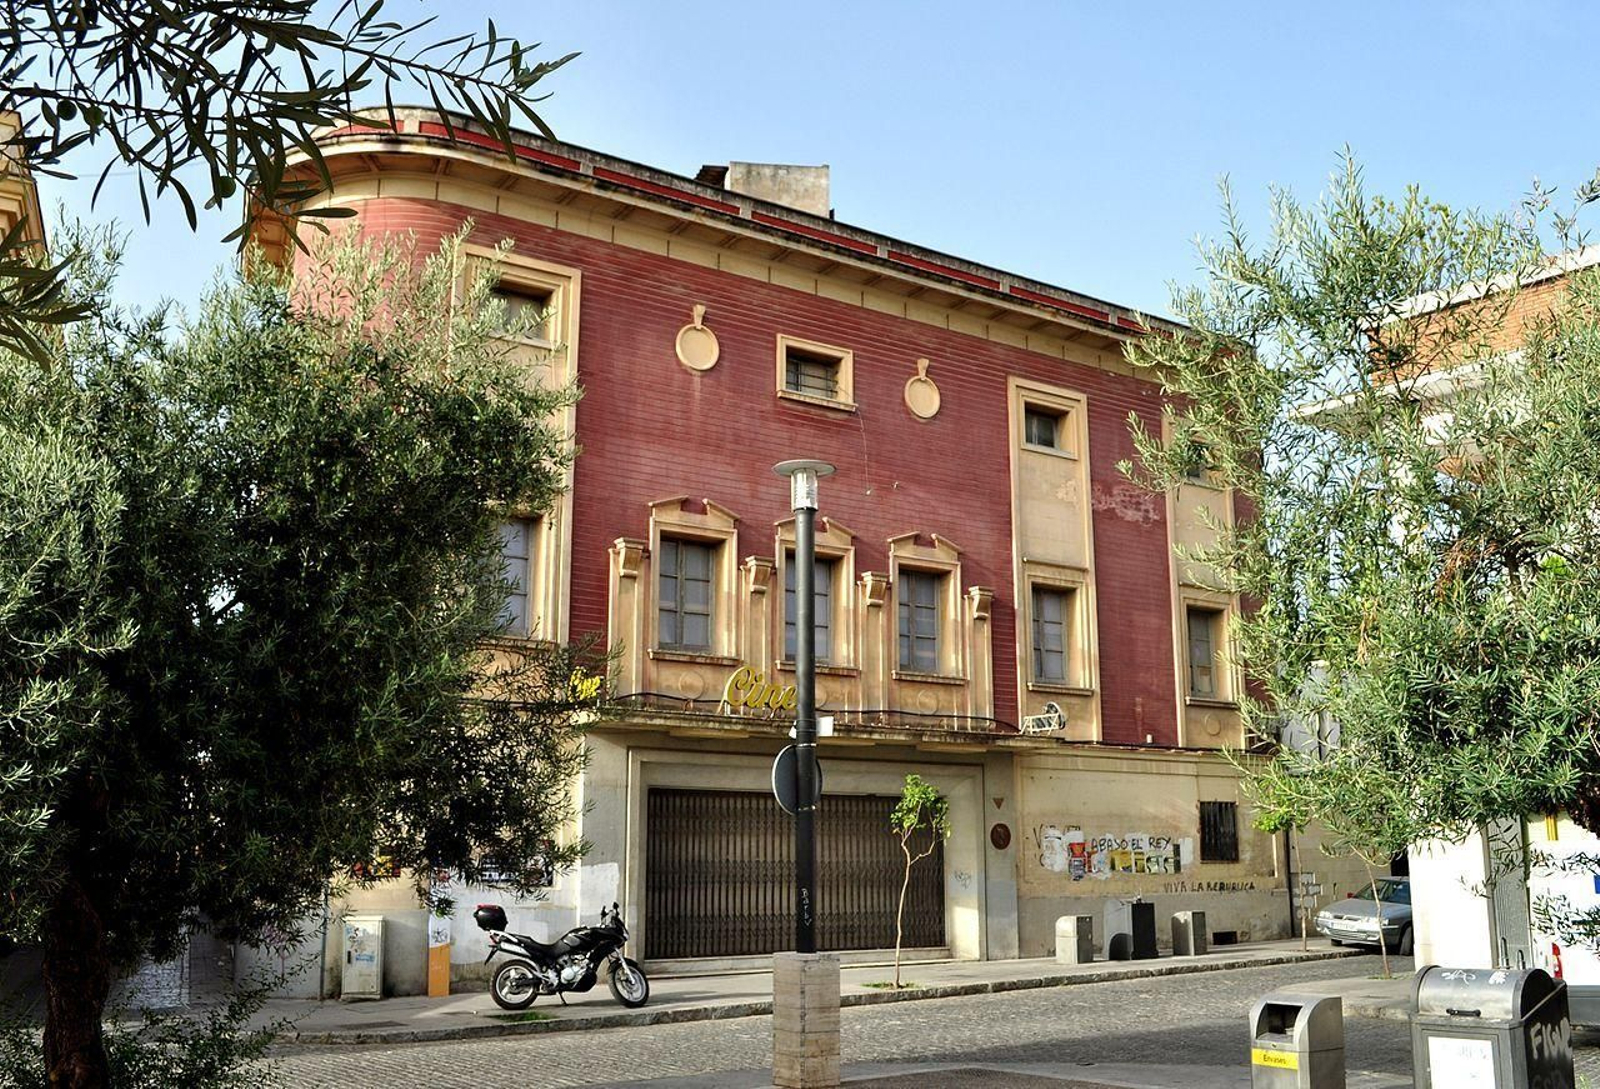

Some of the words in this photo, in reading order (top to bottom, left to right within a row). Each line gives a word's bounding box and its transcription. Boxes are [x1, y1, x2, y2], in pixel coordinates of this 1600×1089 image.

[726, 665, 798, 710] Cine
[1131, 838, 1143, 850] EL
[1148, 836, 1171, 850] REY
[1163, 881, 1187, 893] VIVA
[1191, 882, 1204, 892] LA
